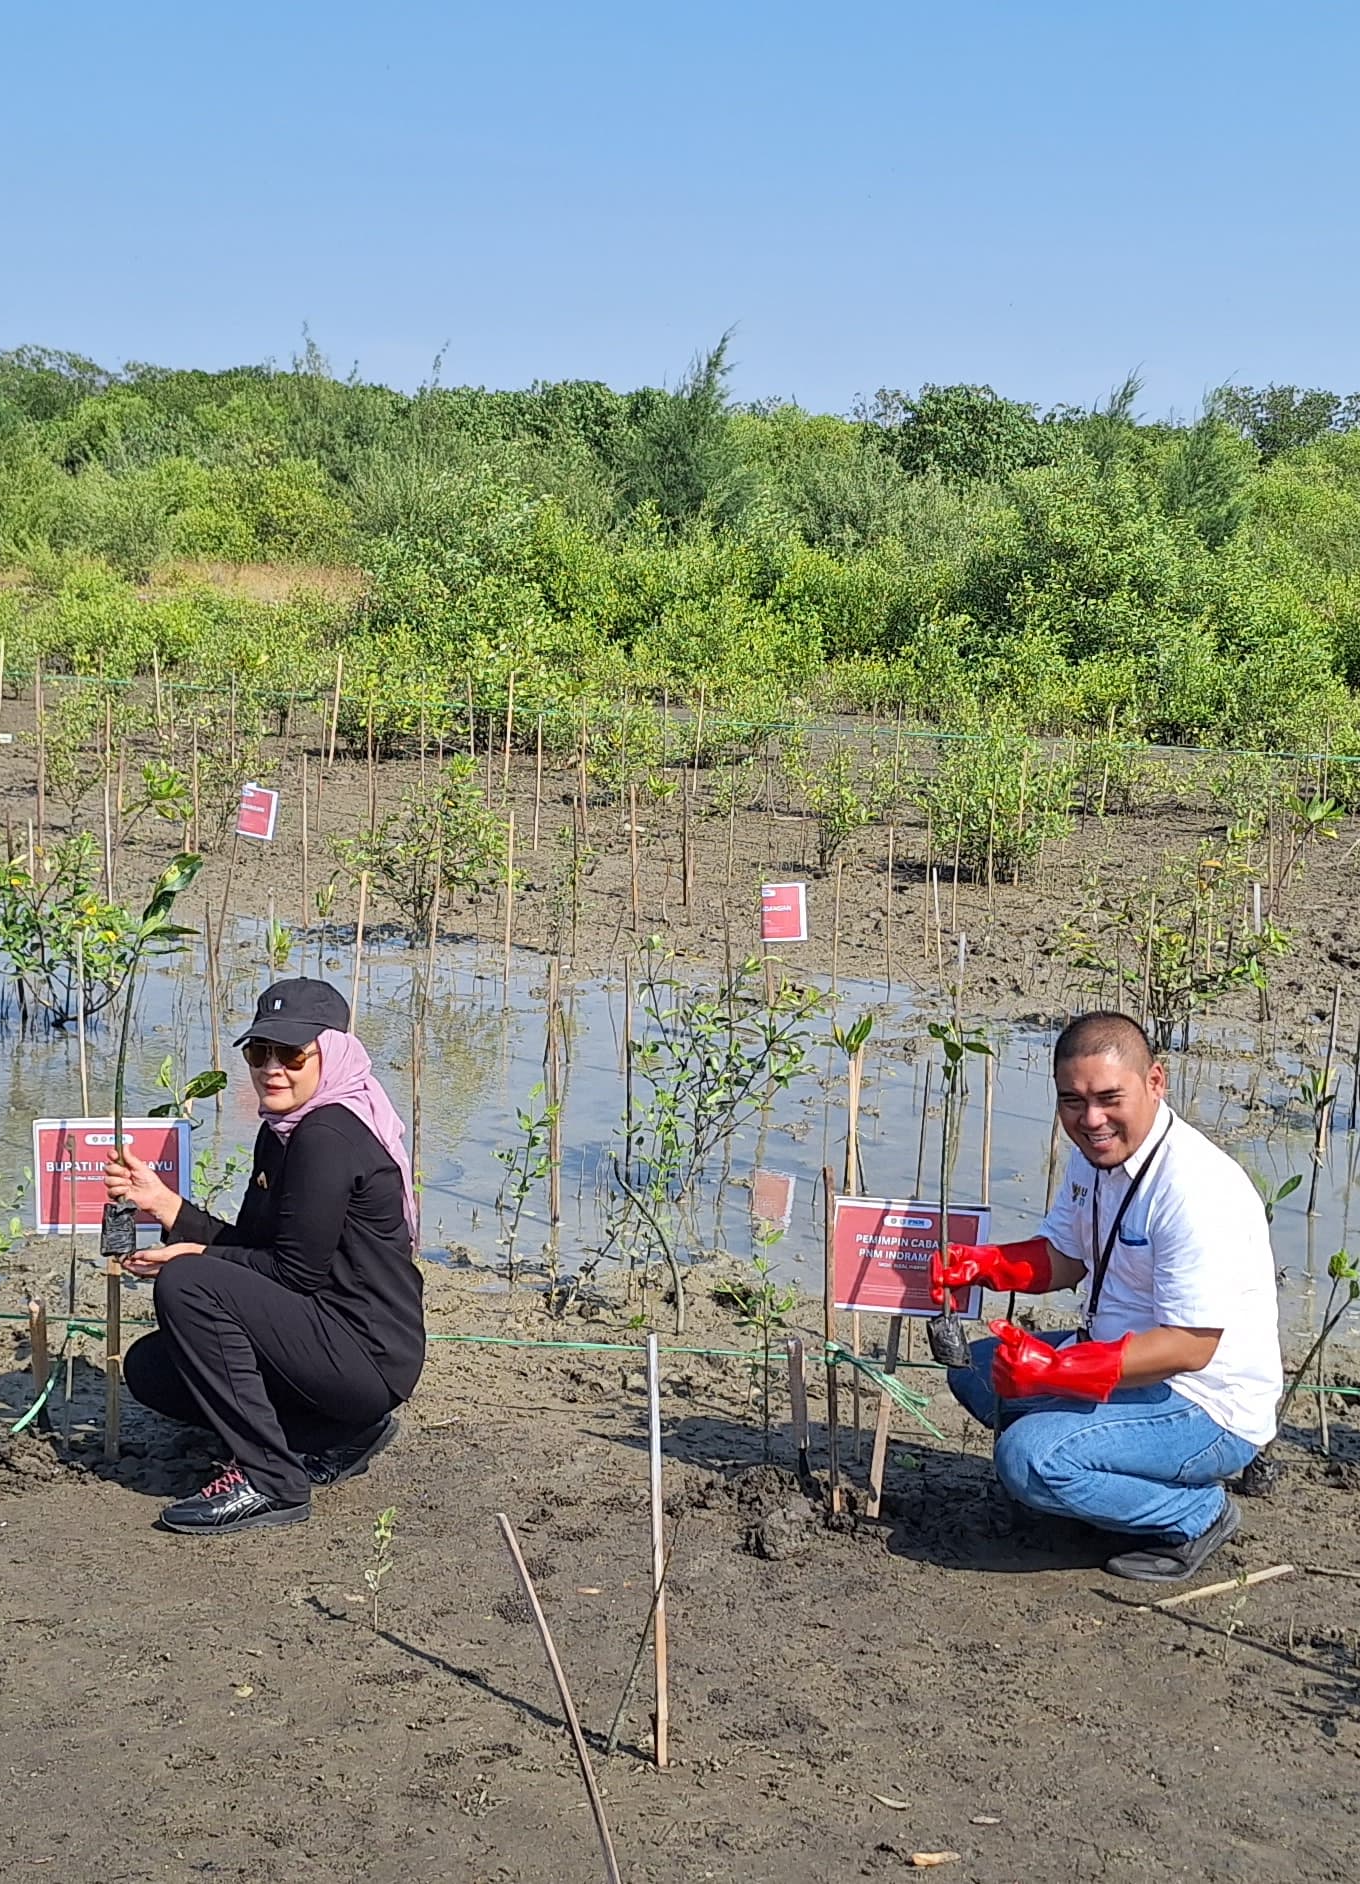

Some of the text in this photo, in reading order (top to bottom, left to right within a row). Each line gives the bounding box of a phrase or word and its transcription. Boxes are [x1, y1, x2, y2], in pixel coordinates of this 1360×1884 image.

[45, 1161, 173, 1172] BUPATI INAYU
[856, 1233, 940, 1249] PEMIMPIN CABA
[859, 1248, 883, 1260] PNM
